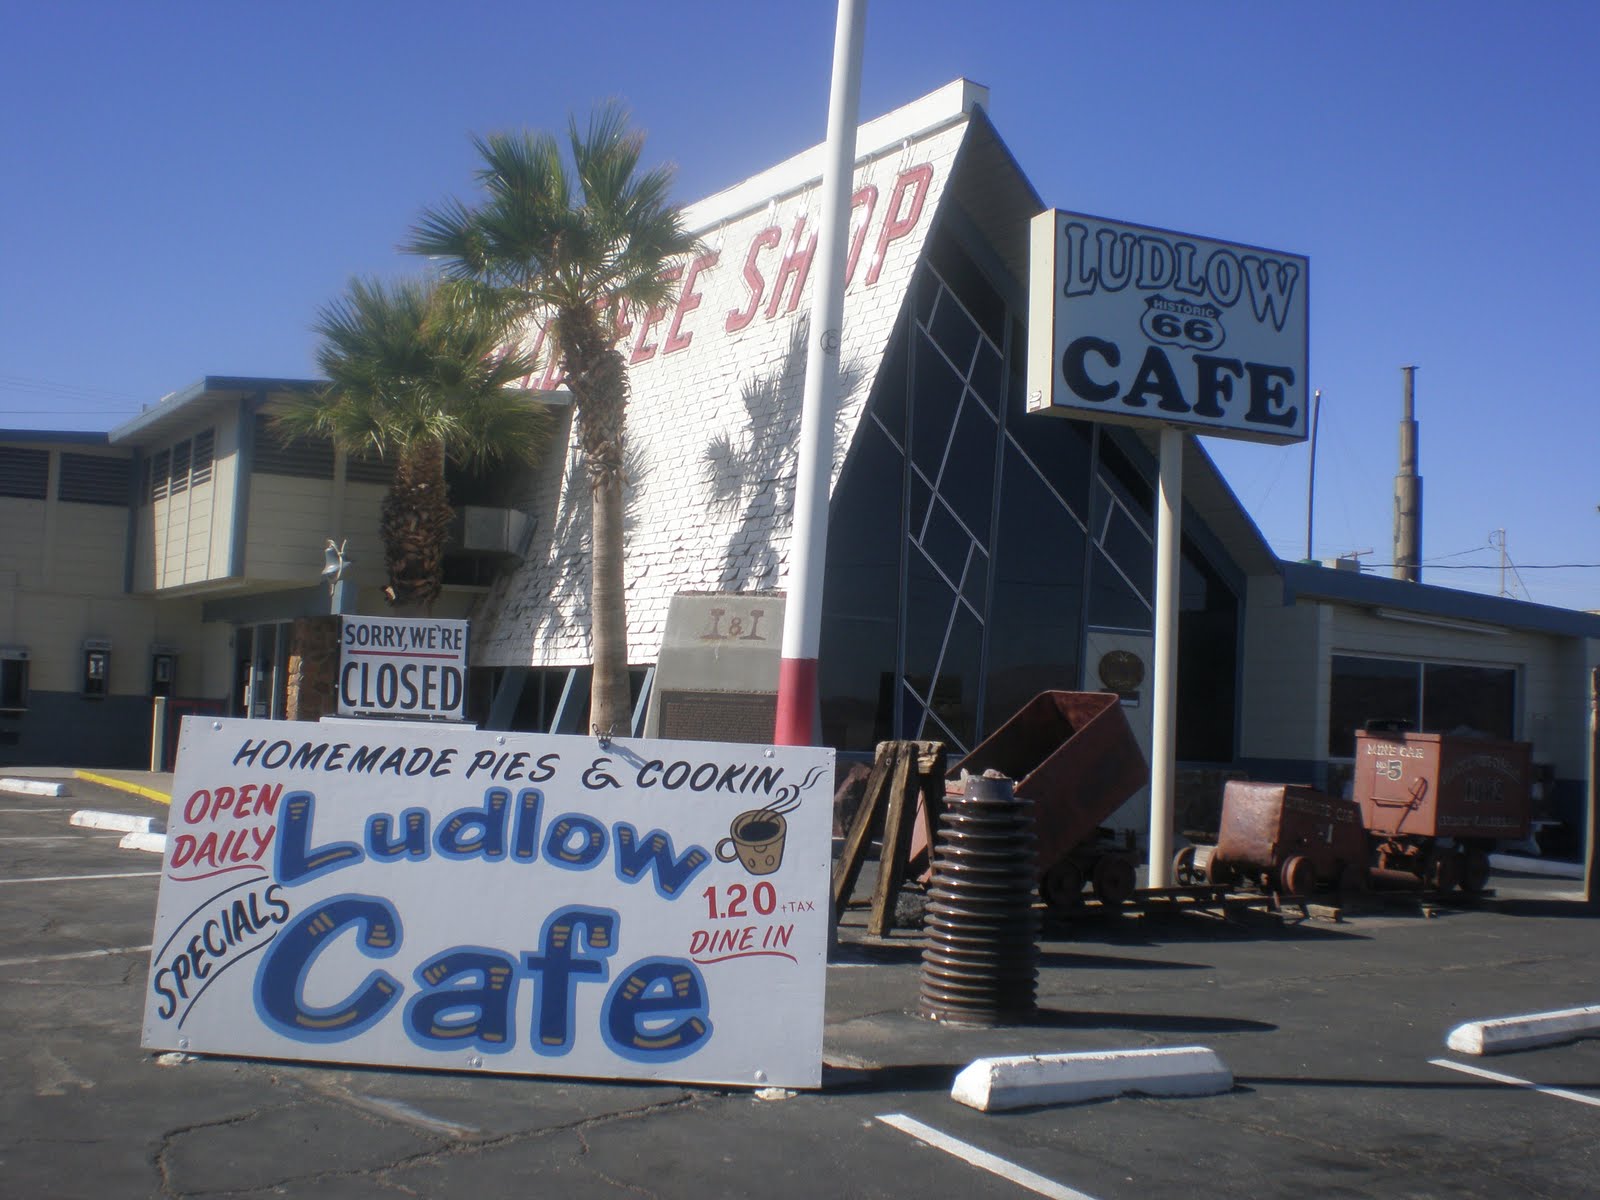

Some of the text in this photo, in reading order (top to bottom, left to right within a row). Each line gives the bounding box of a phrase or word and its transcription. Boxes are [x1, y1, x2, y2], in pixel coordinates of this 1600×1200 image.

[1064, 223, 1300, 333] LUDLOW
[1151, 314, 1214, 343] 66
[1152, 299, 1216, 319] HISTORIC
[1062, 336, 1298, 428] CAFE
[341, 662, 463, 711] CLOSED
[232, 739, 785, 796] HOMEMADE PIES & COOKIN
[1387, 759, 1403, 781] 5
[184, 782, 284, 825] OPEN
[170, 825, 276, 870] DAILY
[273, 787, 712, 901] Ludlow
[702, 881, 777, 919] 1.20
[154, 885, 290, 1020] SPECIALS
[689, 924, 794, 955] DINE IN
[253, 892, 714, 1064] Cafe
